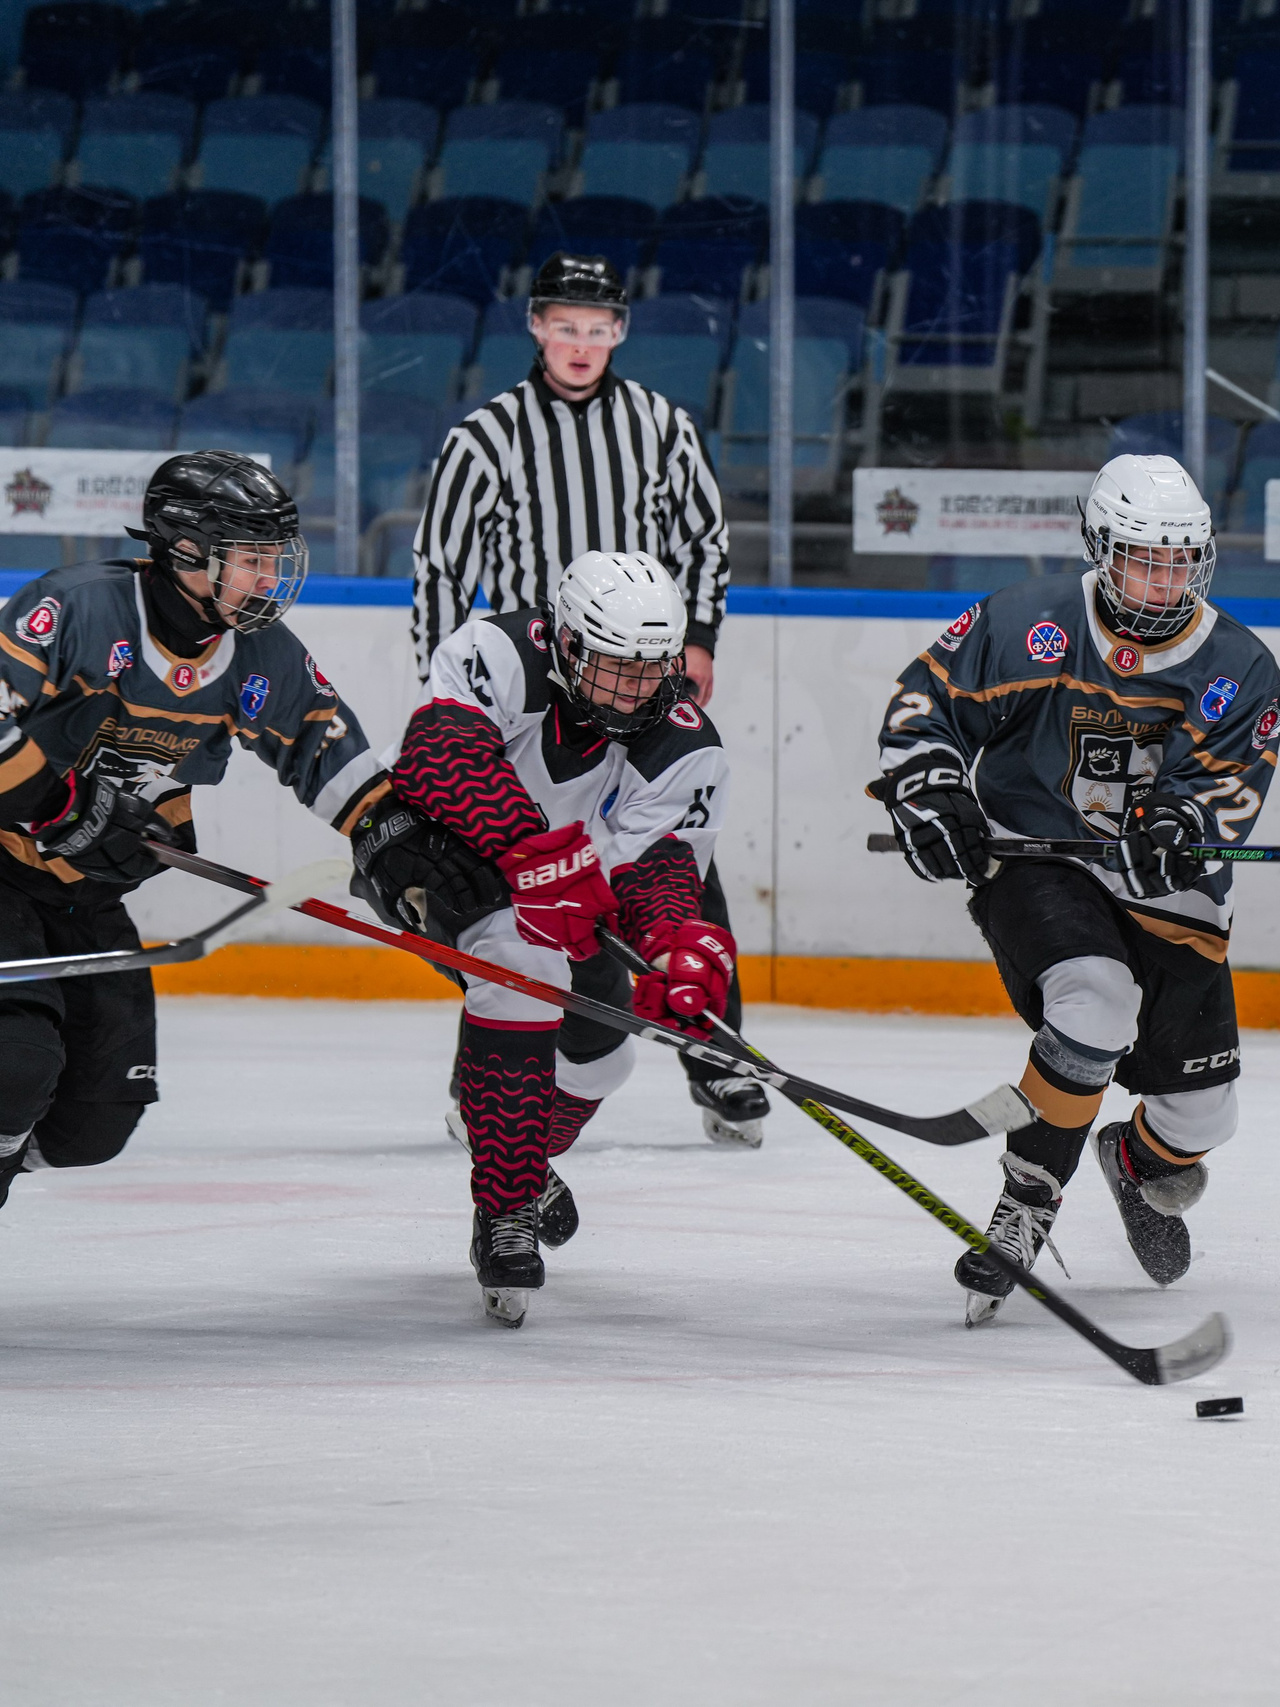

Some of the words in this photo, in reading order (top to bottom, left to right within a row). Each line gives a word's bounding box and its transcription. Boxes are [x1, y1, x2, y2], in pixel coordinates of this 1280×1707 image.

[636, 637, 672, 646] CCM
[1071, 705, 1176, 735] БАЛШИХ
[53, 778, 116, 856] BAUE
[516, 844, 600, 890] BAUE
[639, 1025, 788, 1091] CCM
